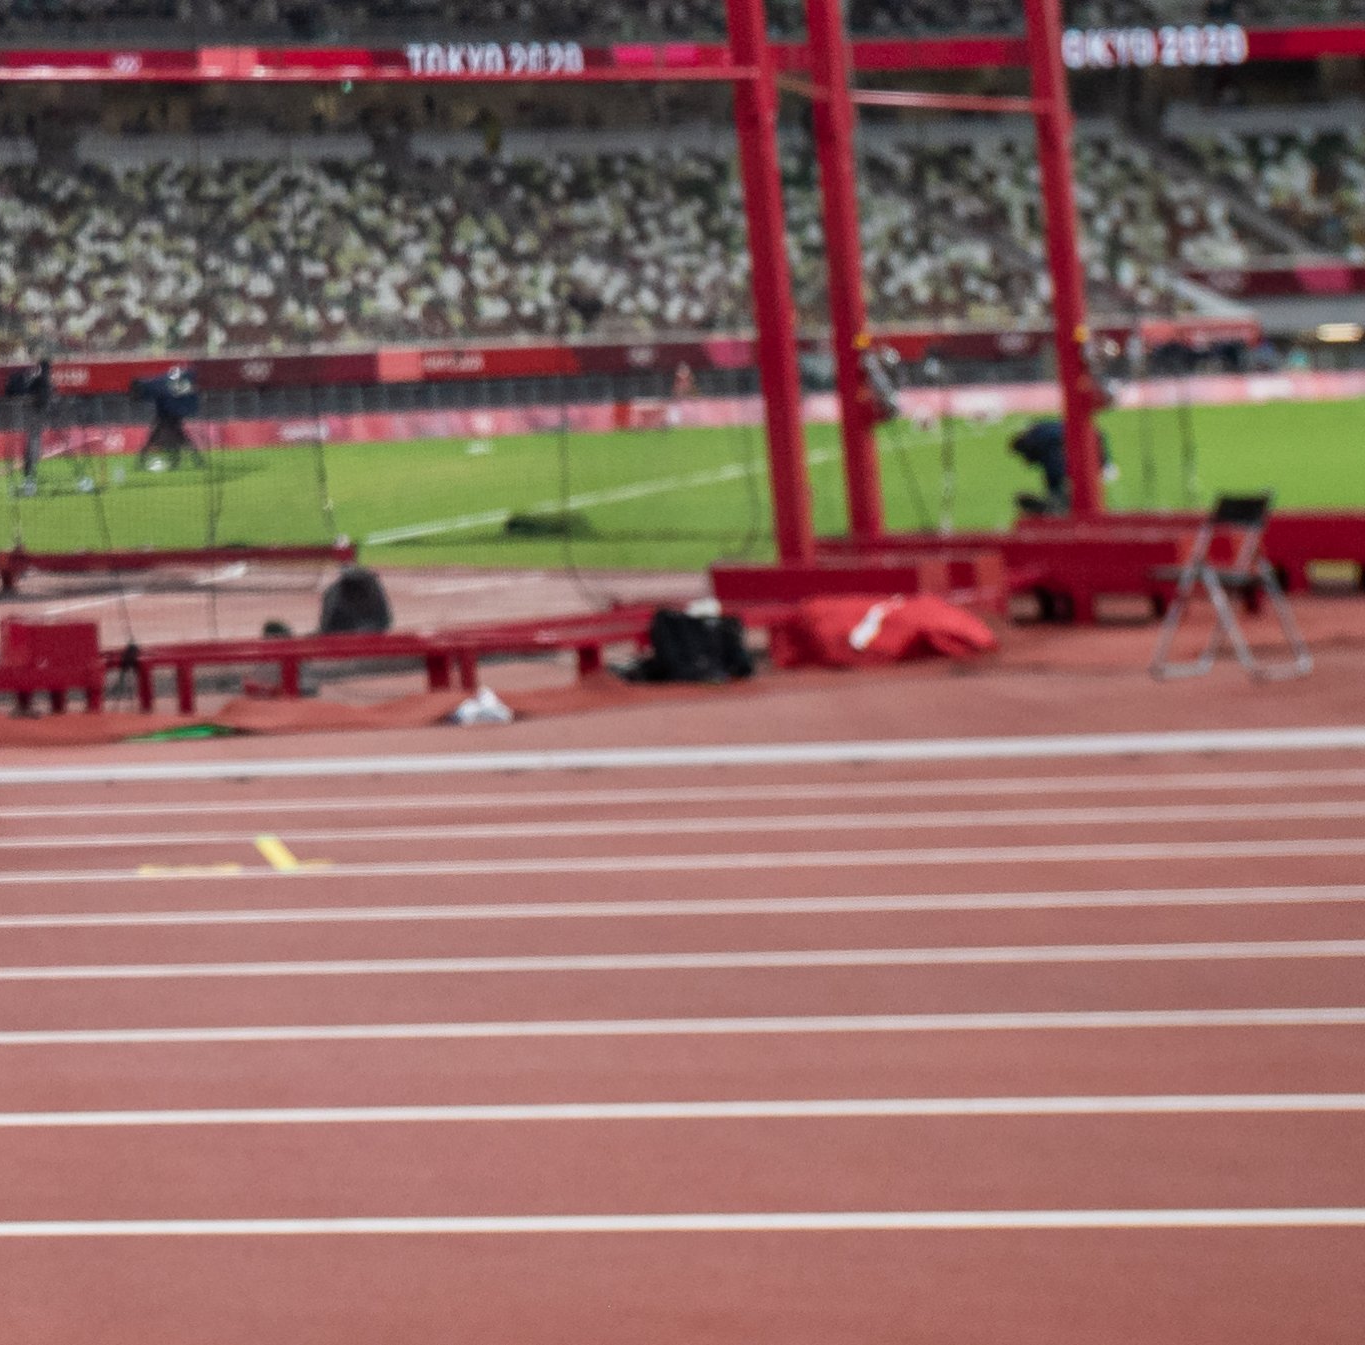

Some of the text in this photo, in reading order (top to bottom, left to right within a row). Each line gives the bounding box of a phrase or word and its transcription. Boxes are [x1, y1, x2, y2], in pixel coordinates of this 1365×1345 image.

[406, 41, 584, 75] TOKYO 2020
[1061, 23, 1249, 69] OKYO 2020
